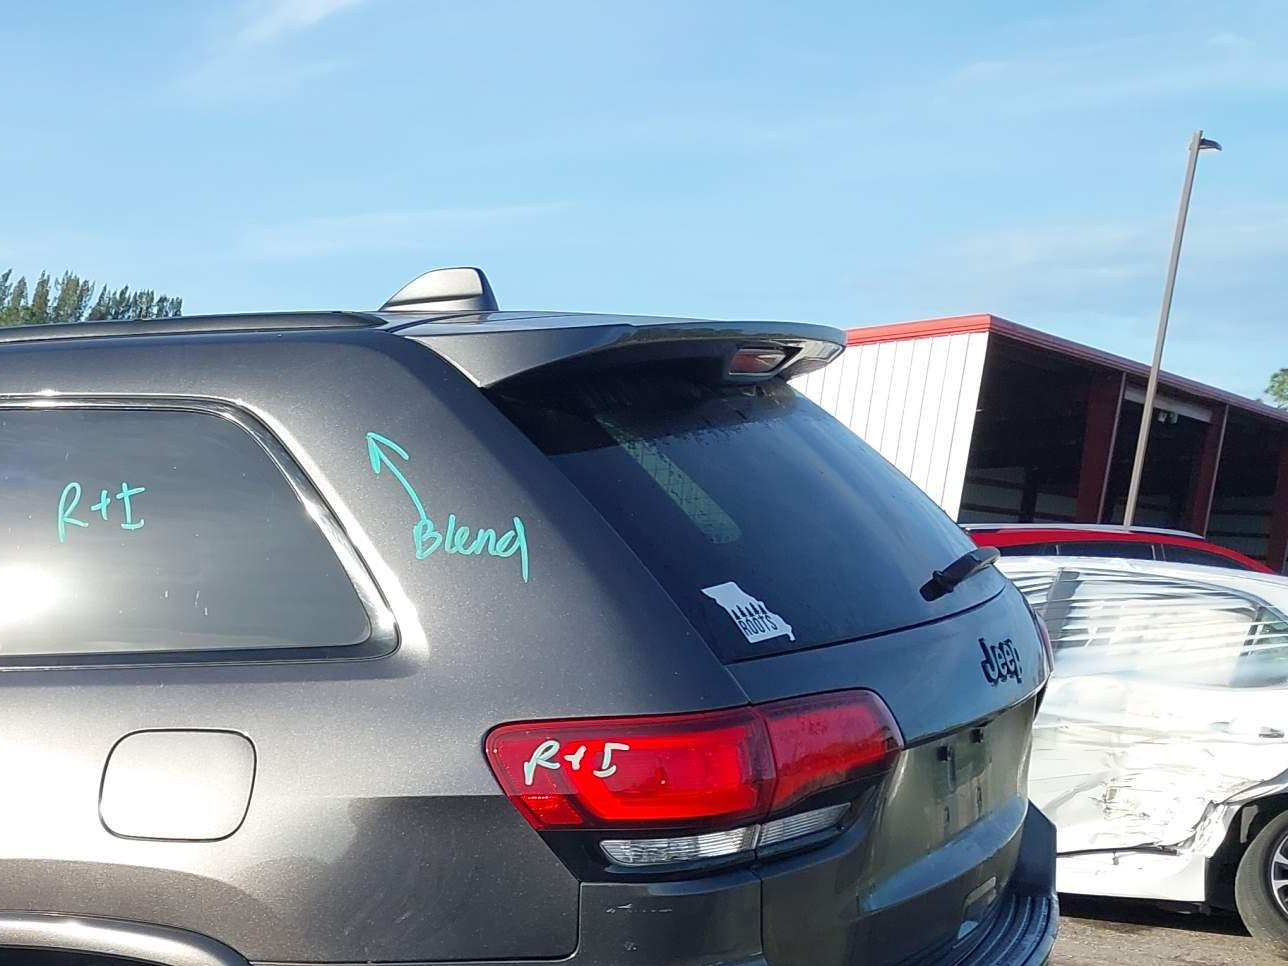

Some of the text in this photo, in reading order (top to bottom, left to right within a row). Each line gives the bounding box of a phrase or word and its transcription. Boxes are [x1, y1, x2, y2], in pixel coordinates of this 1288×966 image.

[413, 513, 530, 584] Blend
[737, 613, 779, 638] ROOTS
[977, 637, 1024, 686] Jeep
